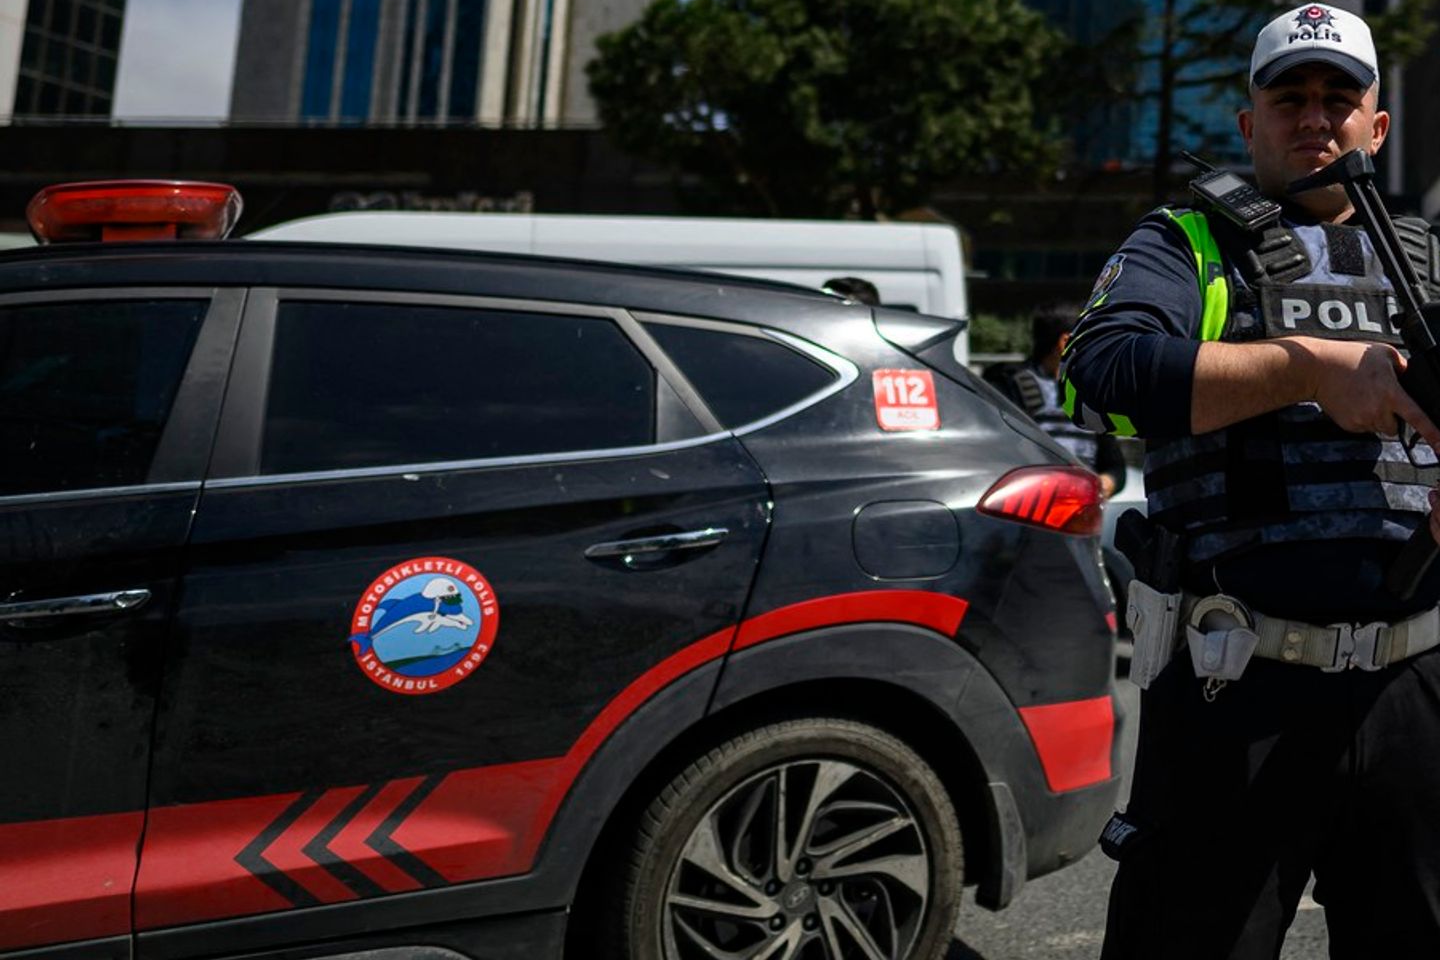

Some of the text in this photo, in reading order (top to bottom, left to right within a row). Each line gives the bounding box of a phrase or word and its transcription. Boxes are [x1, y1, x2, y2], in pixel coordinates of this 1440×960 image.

[1288, 29, 1342, 44] POLİS
[1281, 296, 1402, 336] POLİ
[882, 376, 929, 405] 112
[357, 561, 495, 627] MOTOSİKLETLİ POLİS
[361, 644, 488, 690] İSTANBUL 1993
